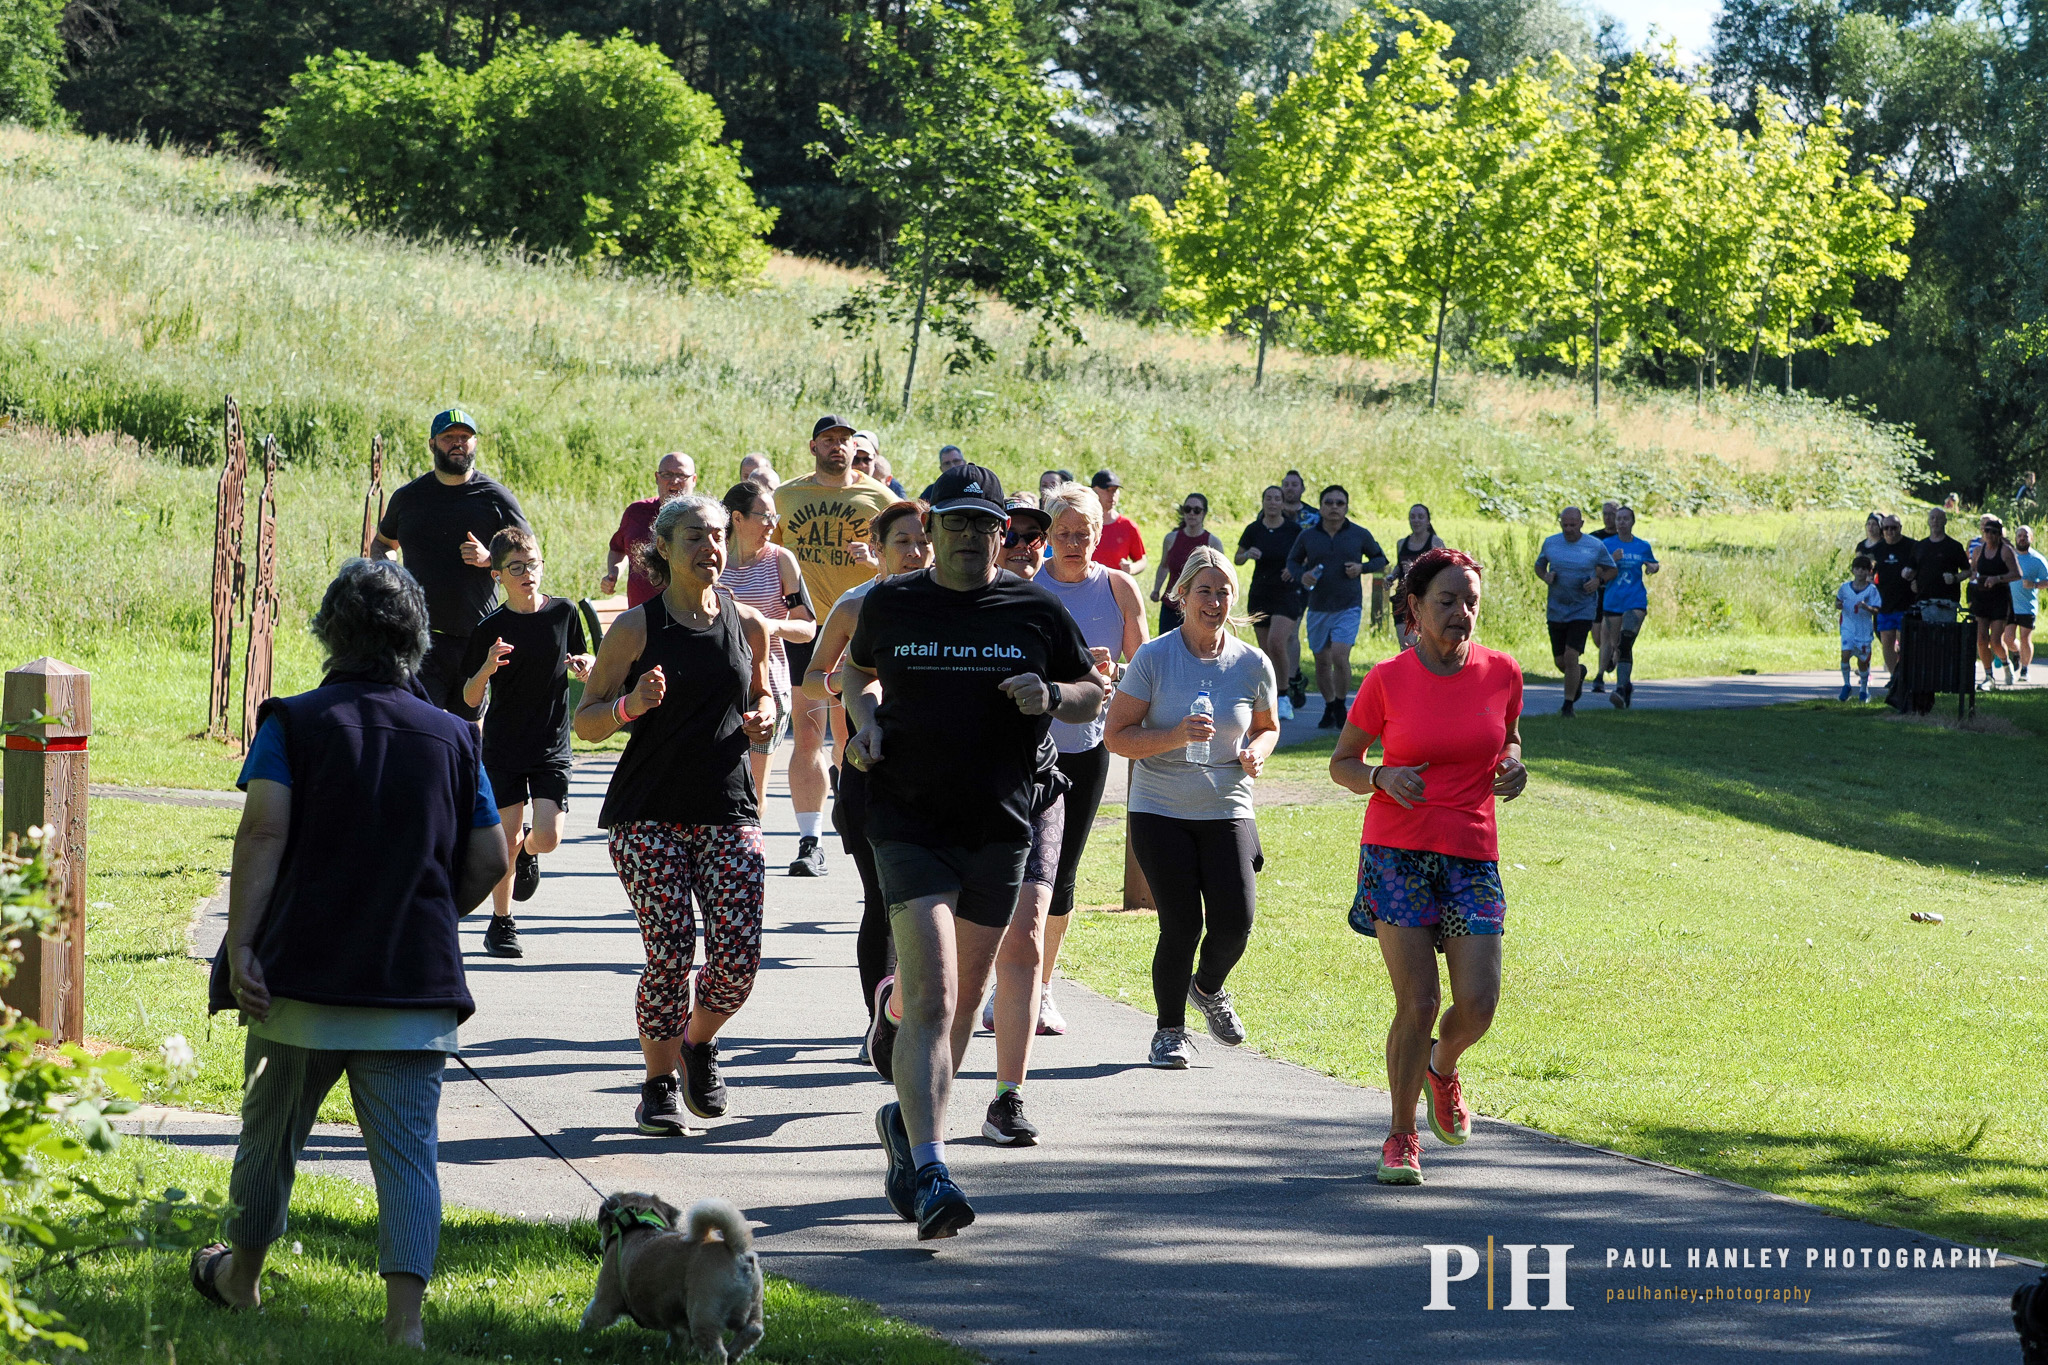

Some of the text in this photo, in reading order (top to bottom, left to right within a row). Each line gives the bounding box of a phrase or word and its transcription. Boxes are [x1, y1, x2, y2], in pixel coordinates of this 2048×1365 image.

[787, 501, 869, 538] MUHAMMAD
[808, 521, 843, 547] ALI
[830, 549, 856, 567] 1974
[894, 642, 1026, 659] retail run club.
